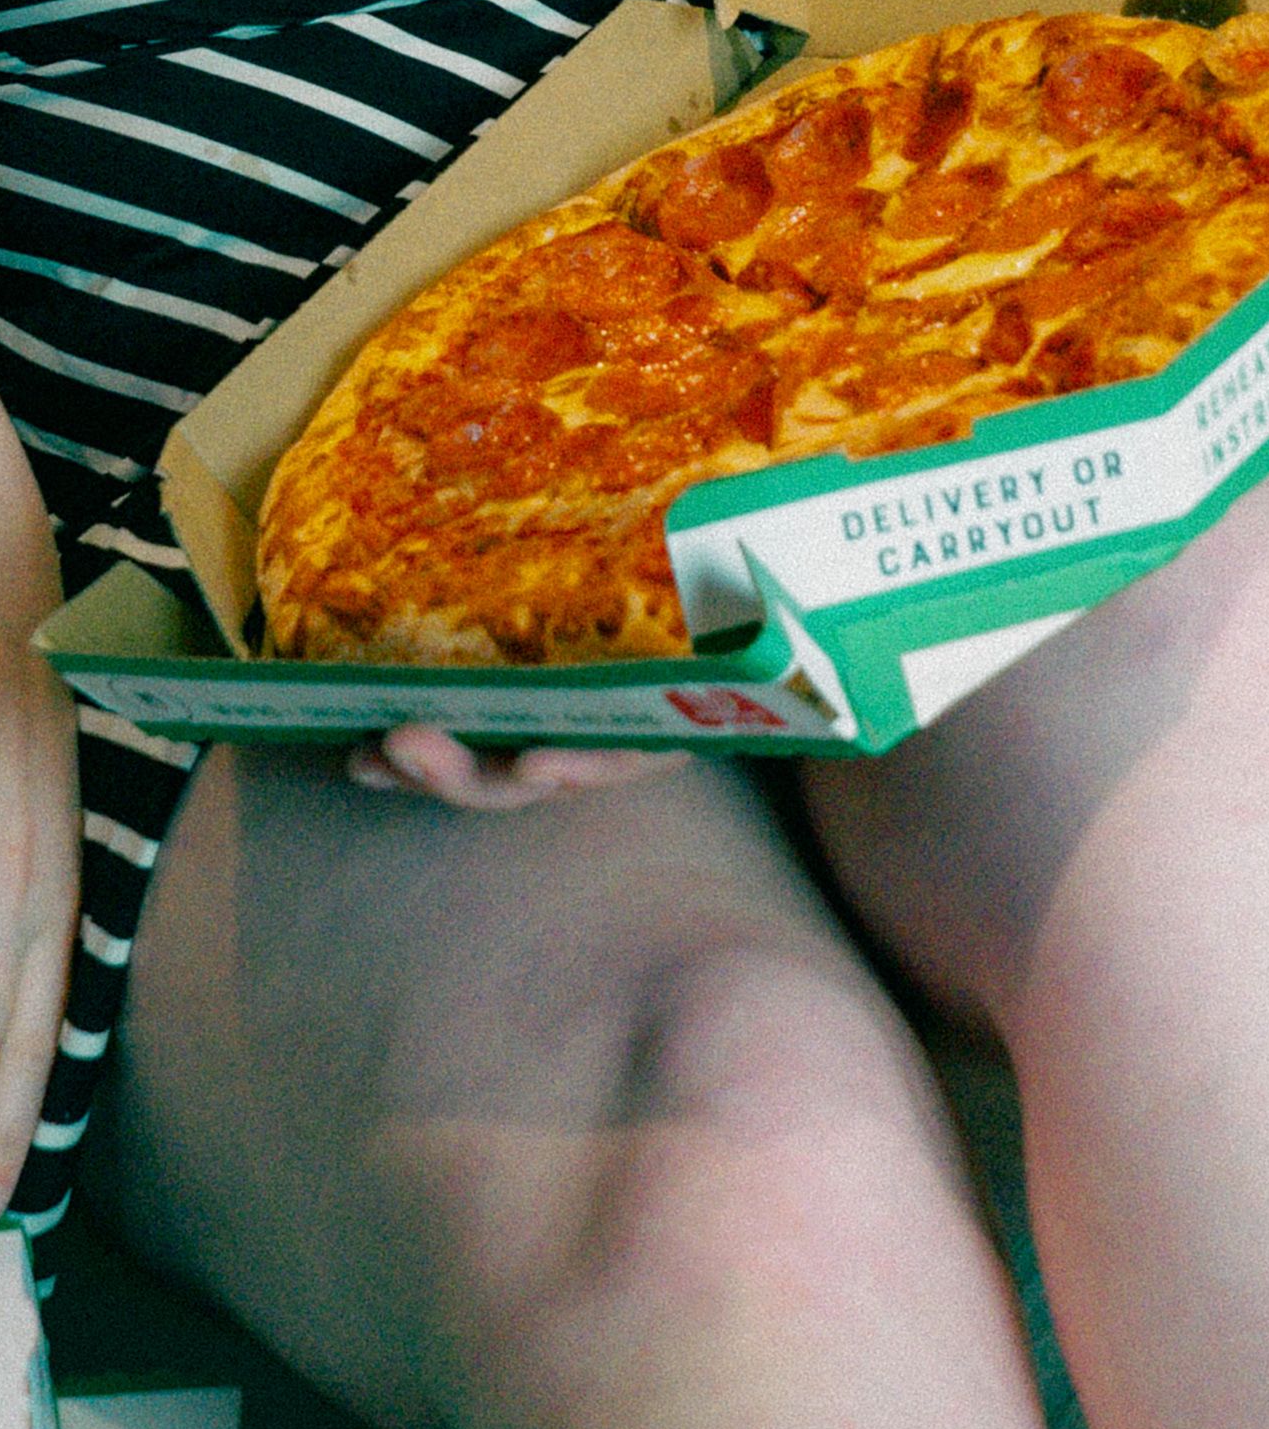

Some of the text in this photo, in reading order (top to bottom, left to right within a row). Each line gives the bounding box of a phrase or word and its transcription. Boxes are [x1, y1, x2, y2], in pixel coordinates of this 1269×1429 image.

[841, 450, 1123, 542] DELIVERY OR
[877, 497, 1102, 576] CARRYOUT
